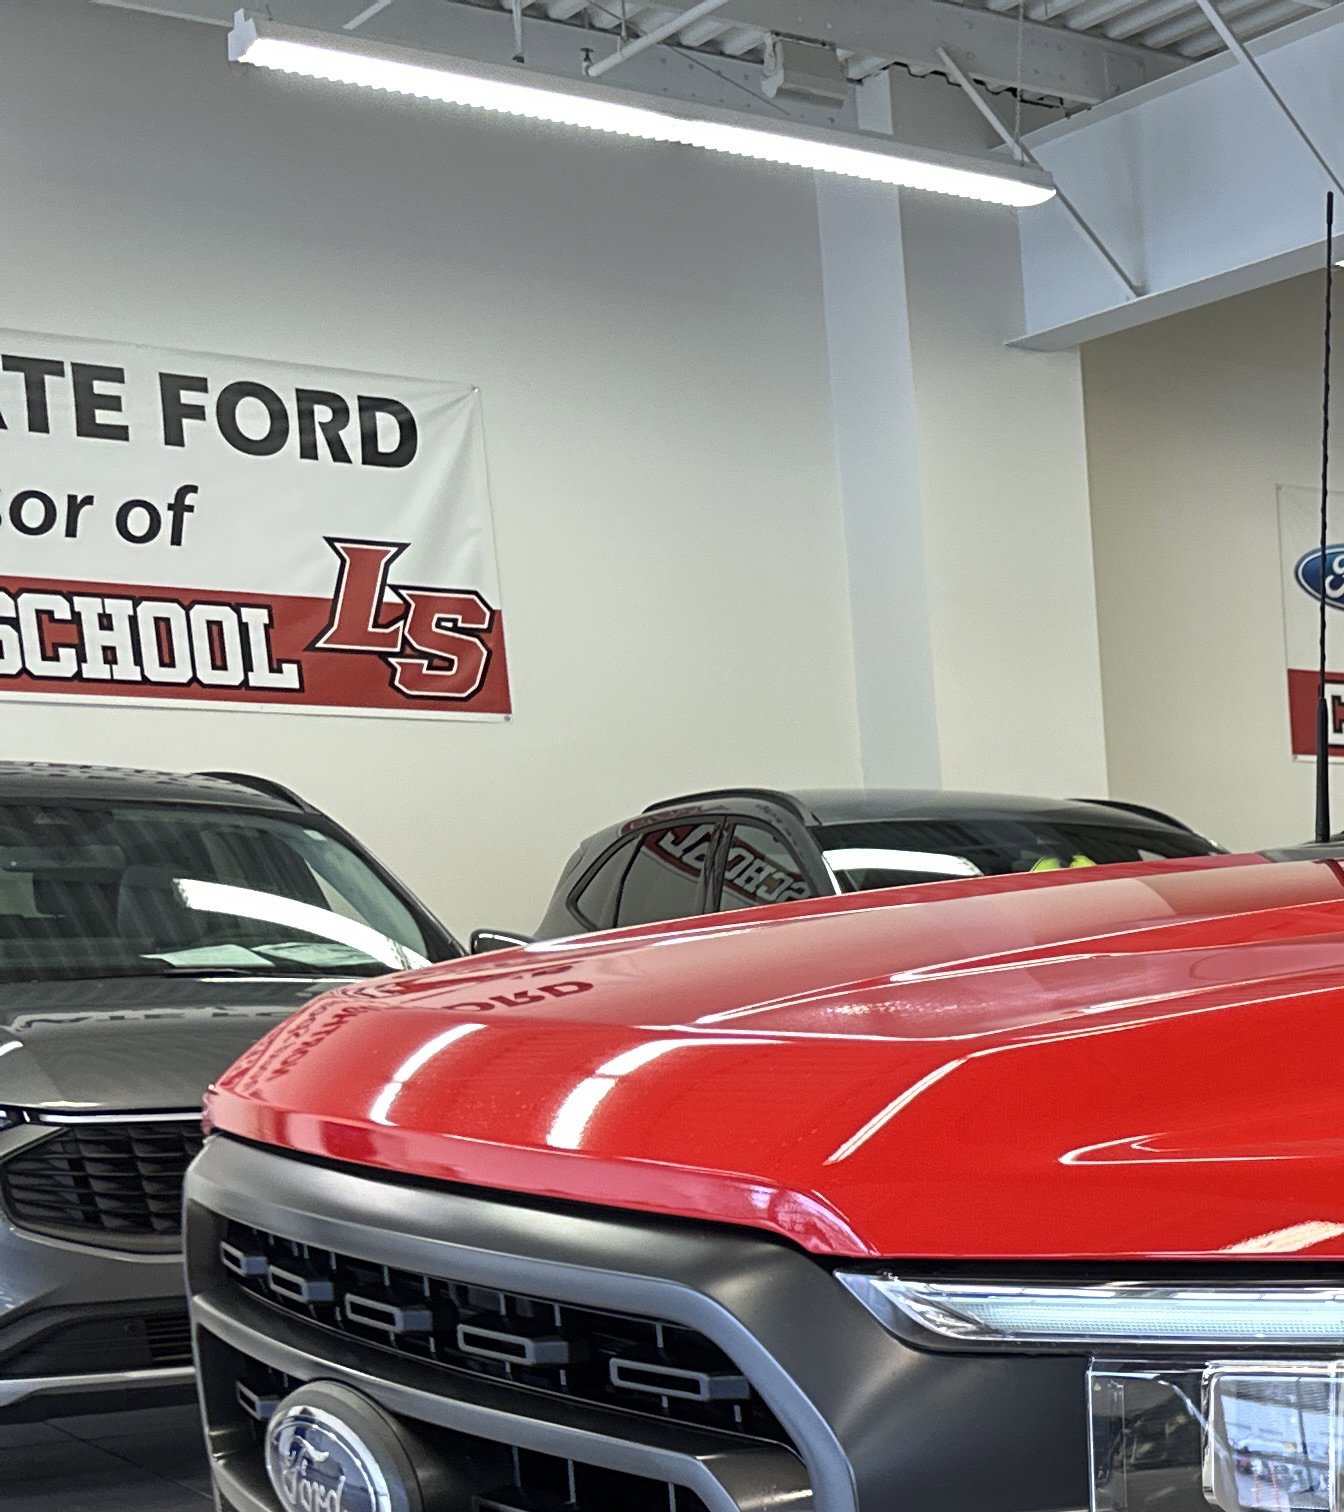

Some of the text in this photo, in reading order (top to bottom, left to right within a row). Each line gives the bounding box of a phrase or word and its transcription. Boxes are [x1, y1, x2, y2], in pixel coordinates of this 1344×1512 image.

[0, 354, 418, 468] TE FORD
[0, 484, 199, 546] or of
